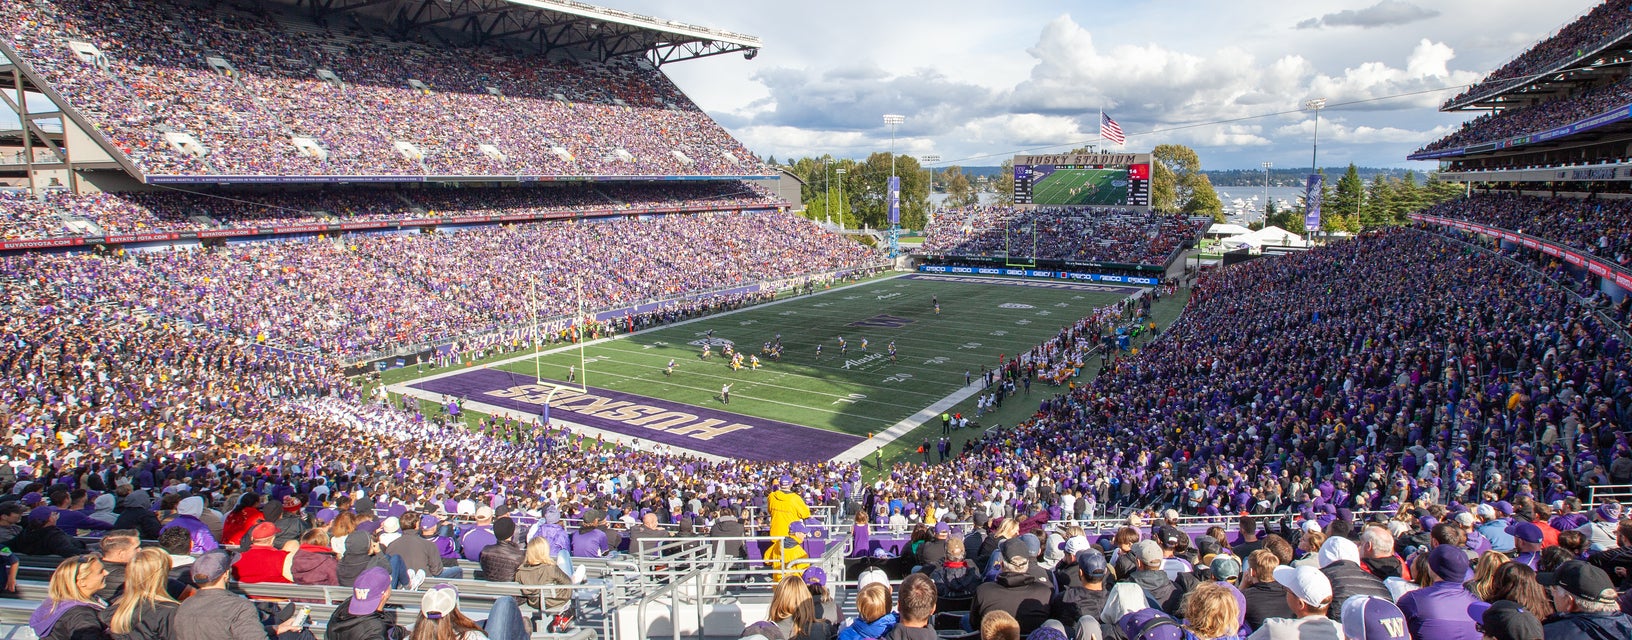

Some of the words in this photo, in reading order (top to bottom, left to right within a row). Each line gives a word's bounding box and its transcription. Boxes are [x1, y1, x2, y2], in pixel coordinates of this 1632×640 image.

[1026, 156, 1069, 164] HUSKY
[1075, 155, 1136, 164] STADIUM
[4, 240, 71, 249] BUYATOYOTA.COM
[545, 319, 568, 333] THE
[841, 352, 884, 369] Alaska
[482, 384, 754, 441] HUSKIES
[354, 587, 370, 600] W
[1379, 616, 1405, 638] W
